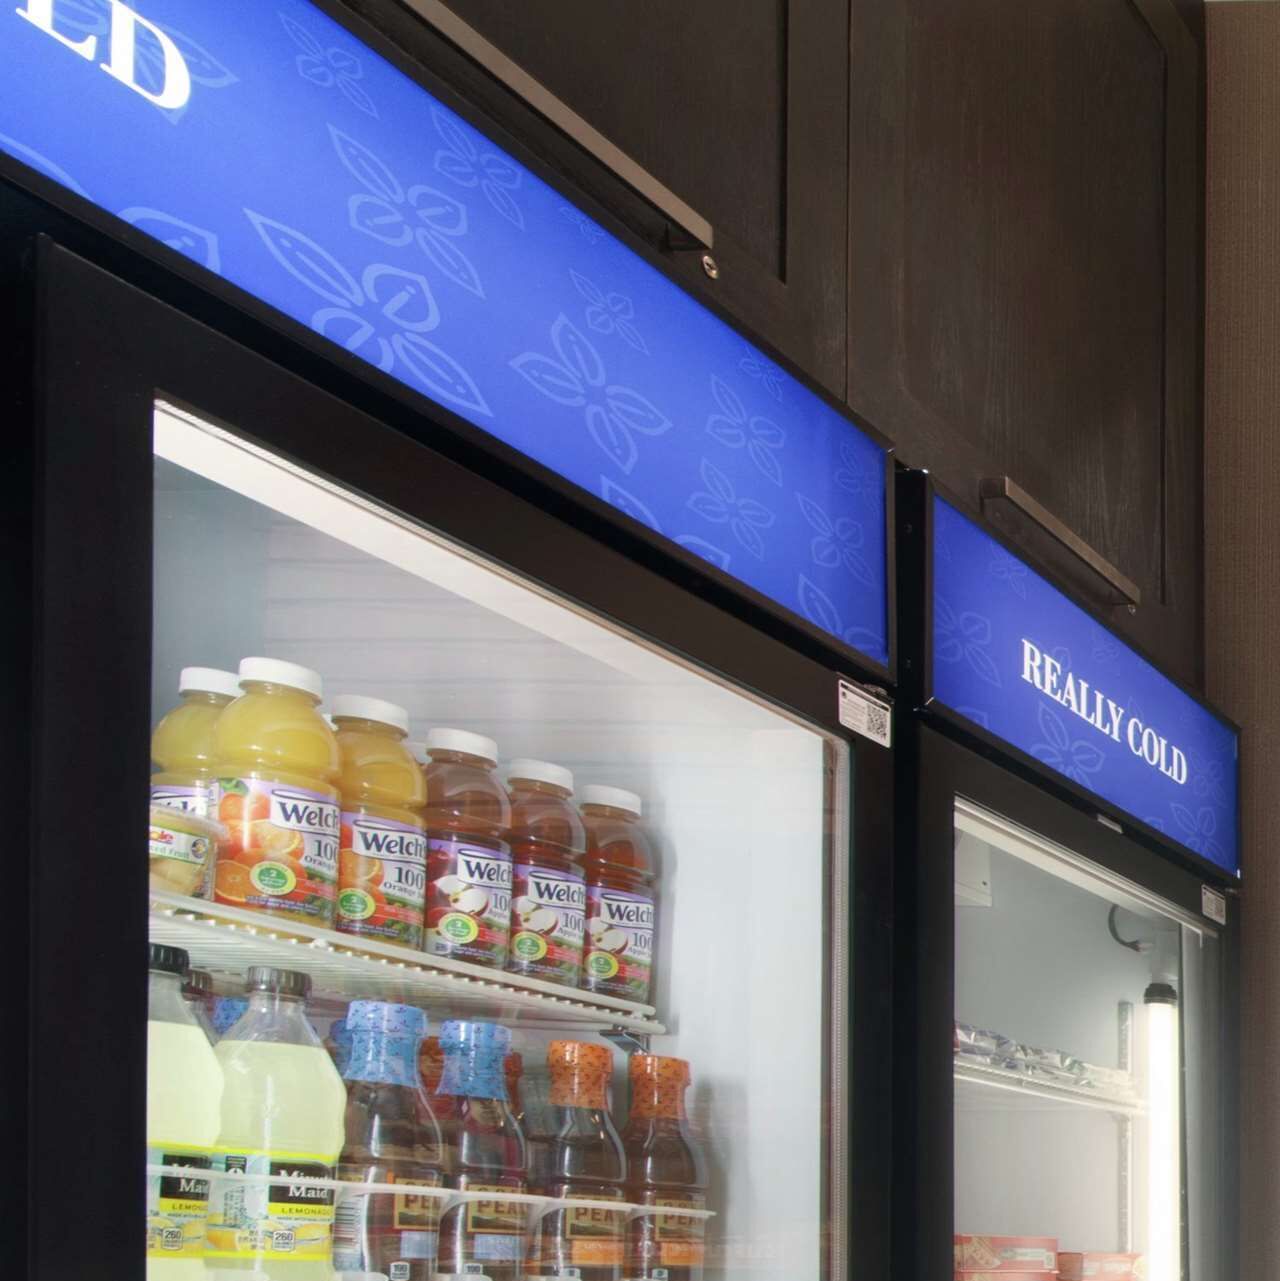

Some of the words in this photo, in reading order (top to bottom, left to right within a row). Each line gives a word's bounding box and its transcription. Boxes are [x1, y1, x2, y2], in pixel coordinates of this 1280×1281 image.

[1020, 638, 1124, 743] REALLY
[1126, 716, 1188, 785] COLD
[288, 1183, 329, 1199] Maid
[164, 1230, 182, 1241] 260
[274, 1231, 293, 1242] 260
